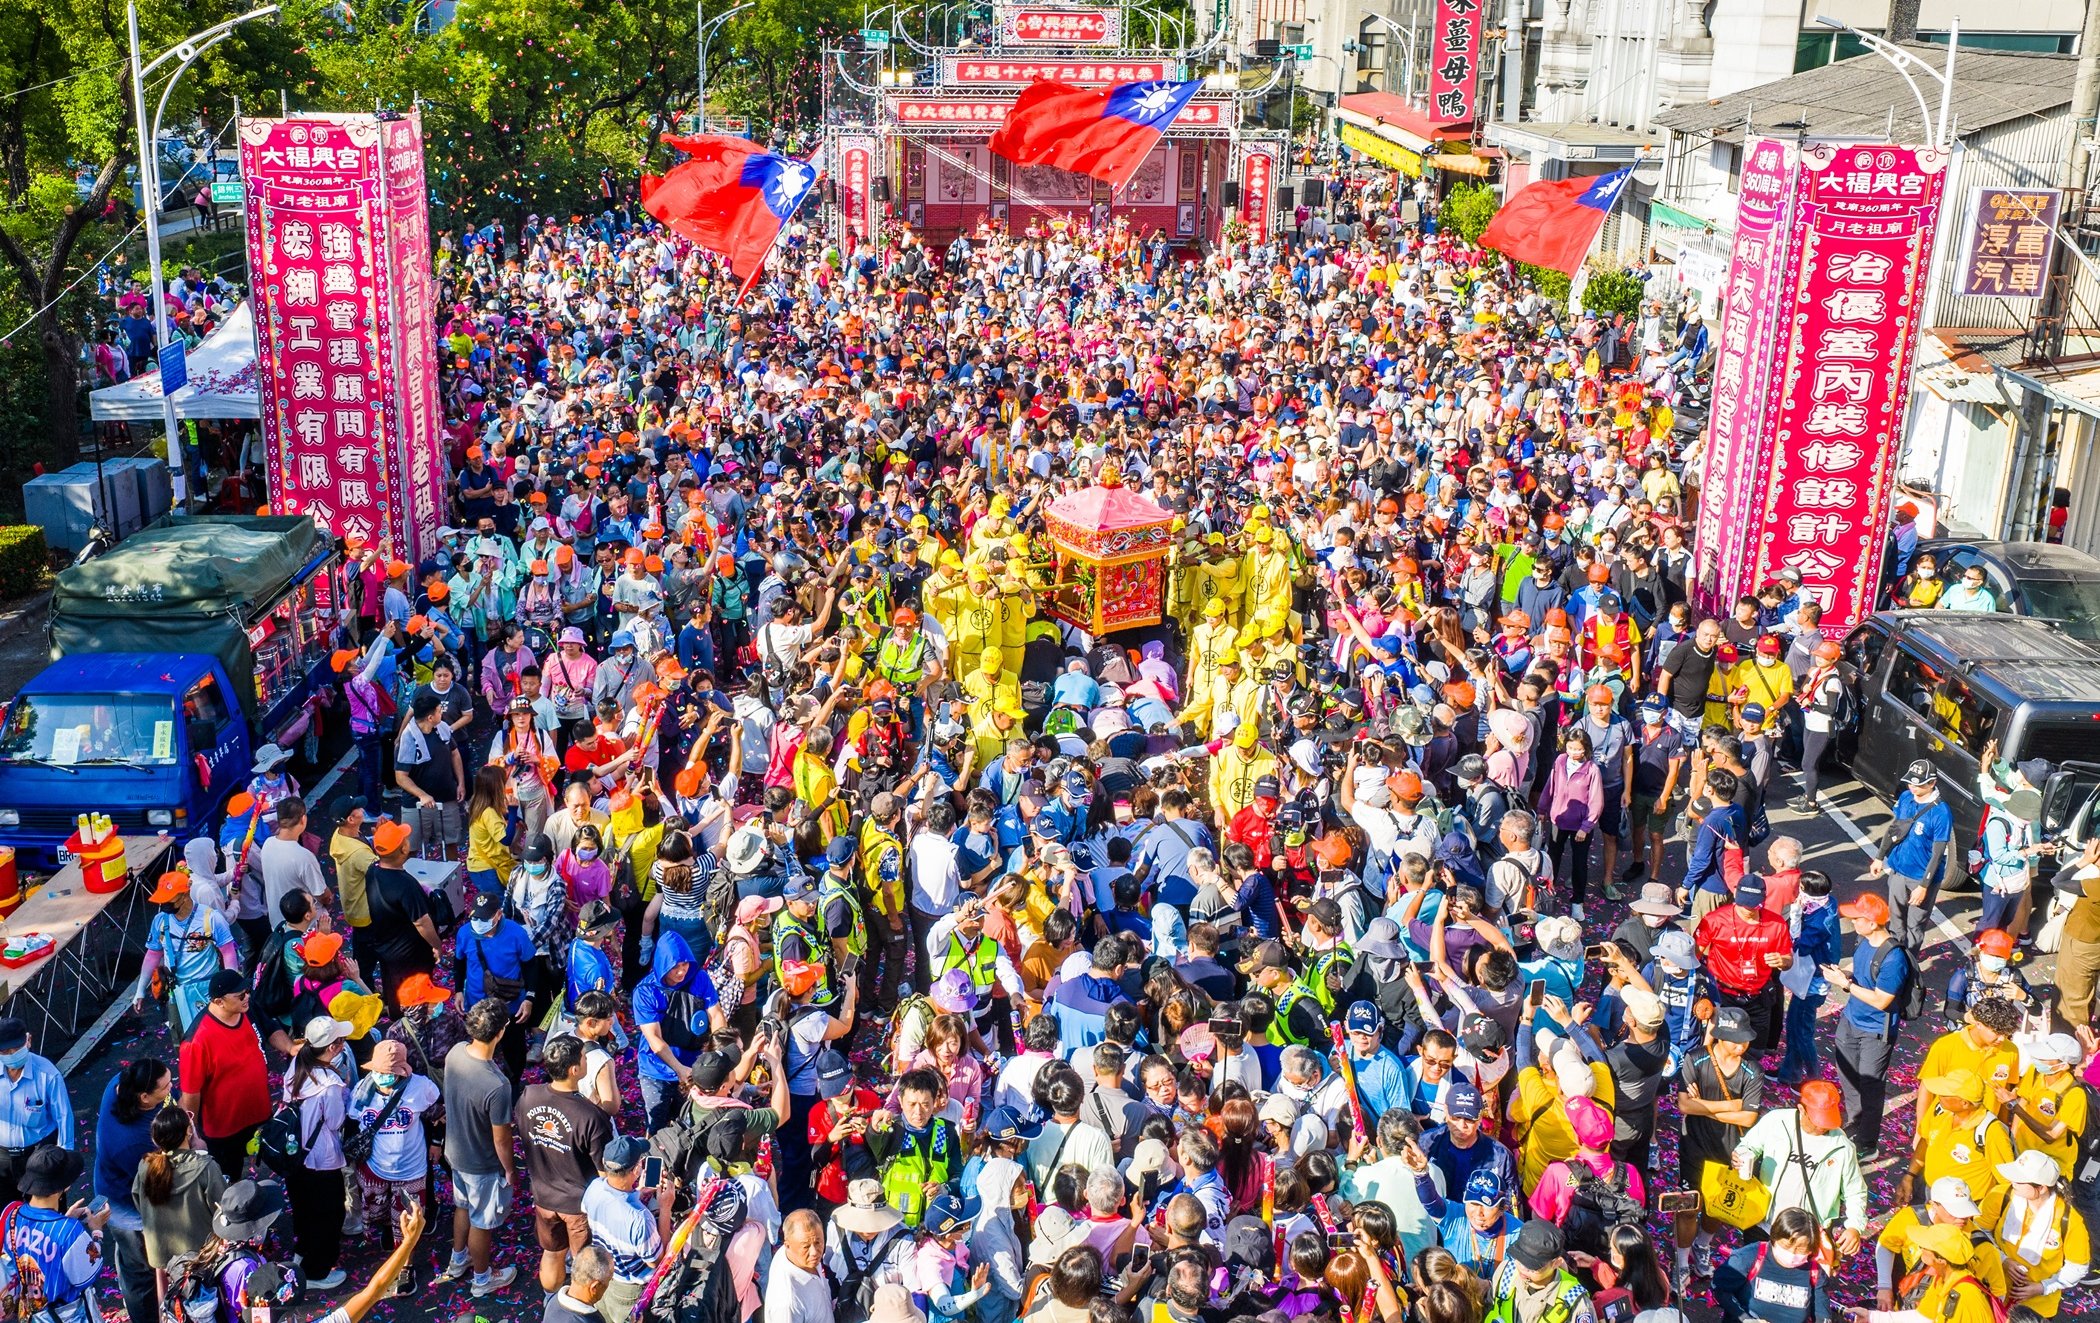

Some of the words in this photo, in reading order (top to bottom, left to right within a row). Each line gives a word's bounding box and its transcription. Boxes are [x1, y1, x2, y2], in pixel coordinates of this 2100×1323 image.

[260, 146, 361, 170] 大福興宮
[279, 174, 345, 187] 建廟360周年
[1744, 171, 1782, 198] 360周年
[1818, 171, 1925, 197] 大福興宮
[278, 193, 349, 208] 月老祖廟
[1833, 201, 1904, 213] 建廟360周年
[1827, 220, 1904, 235] 月老祖廟
[1978, 223, 2049, 255] 淳富
[1971, 261, 2042, 292] 汽車
